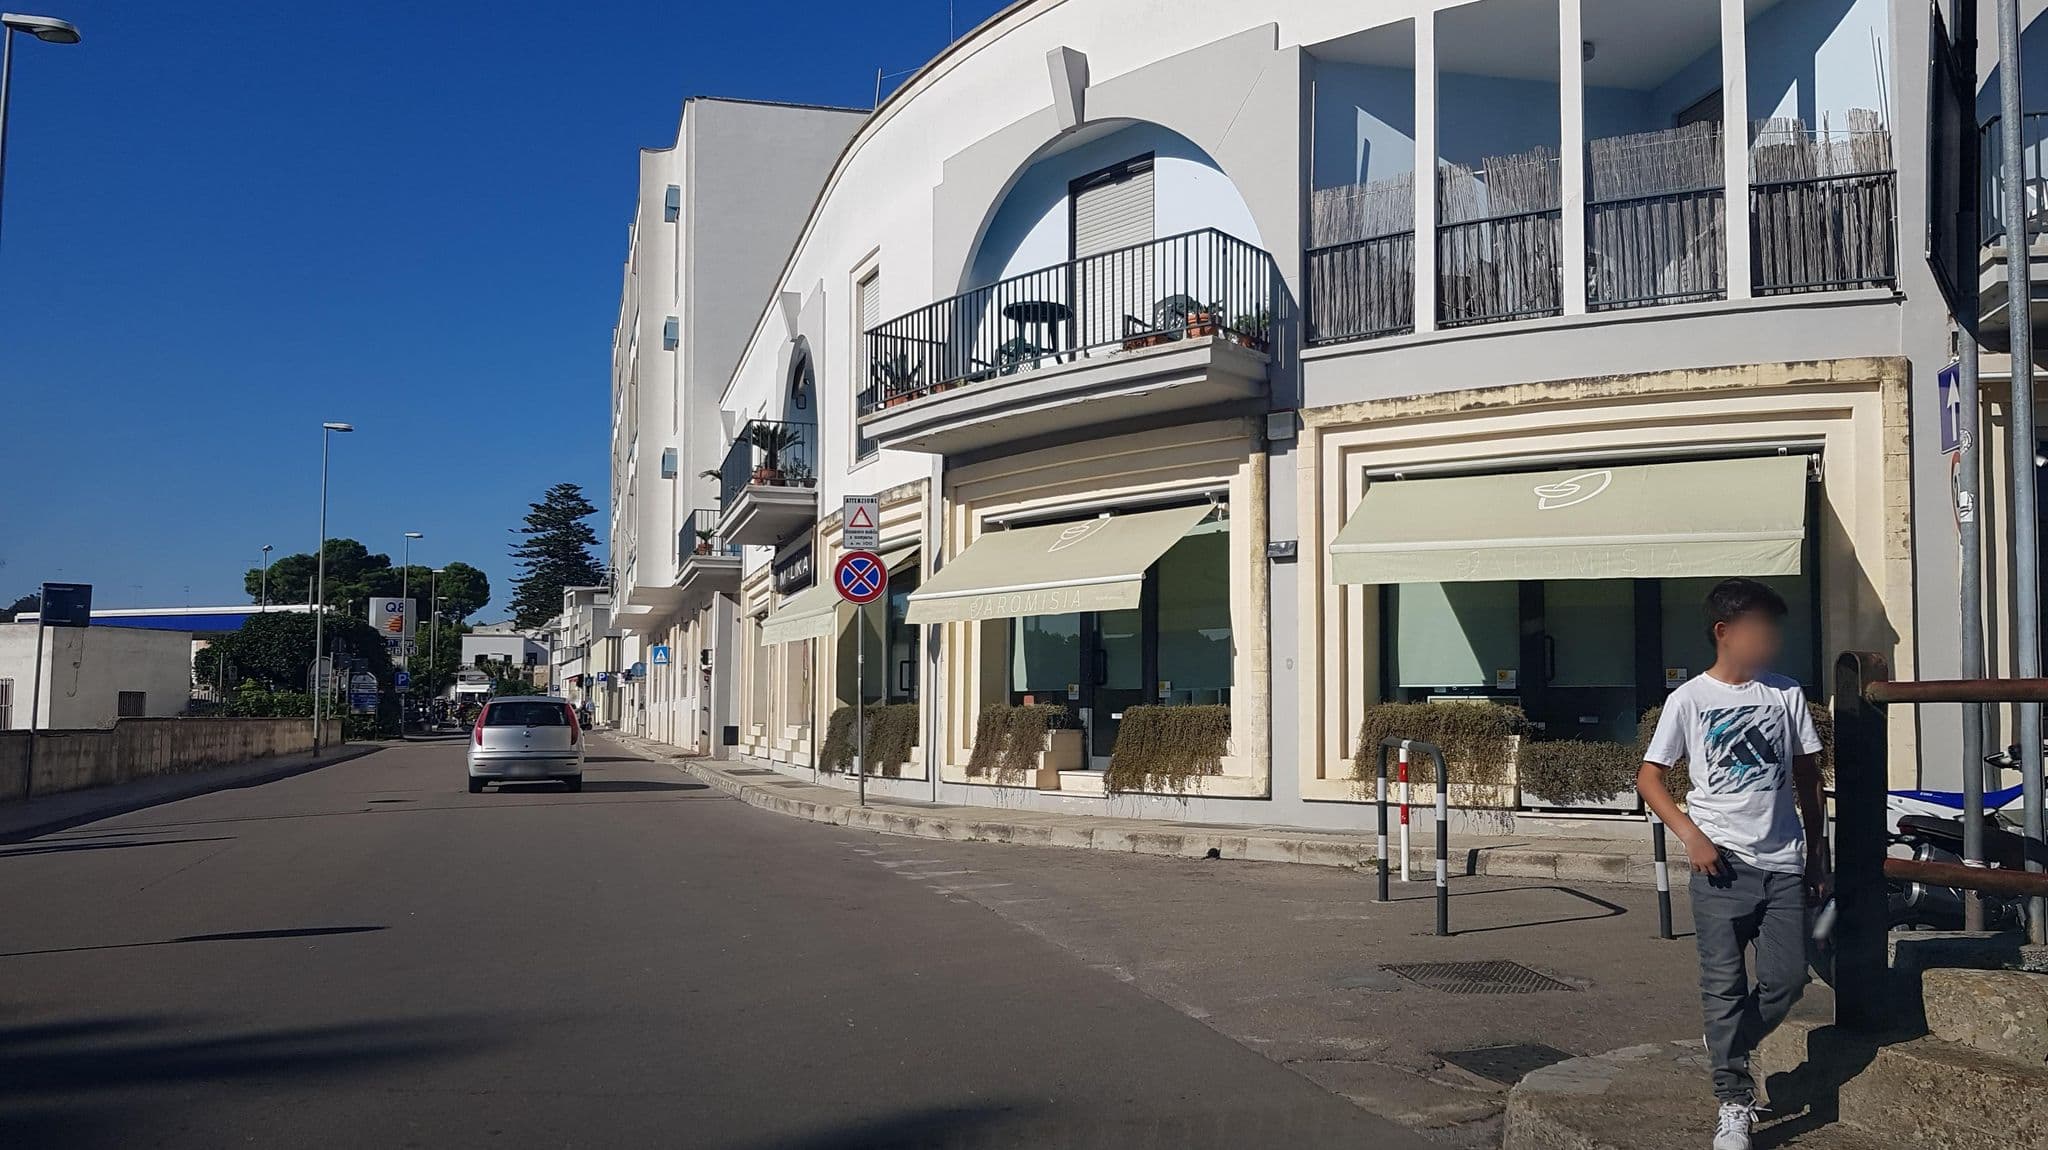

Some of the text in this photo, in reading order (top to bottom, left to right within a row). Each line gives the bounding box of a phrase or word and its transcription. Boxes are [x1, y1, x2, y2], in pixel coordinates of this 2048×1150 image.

[385, 602, 405, 612] Q8
[984, 590, 1081, 615] AROMISIA
[399, 674, 407, 684] P
